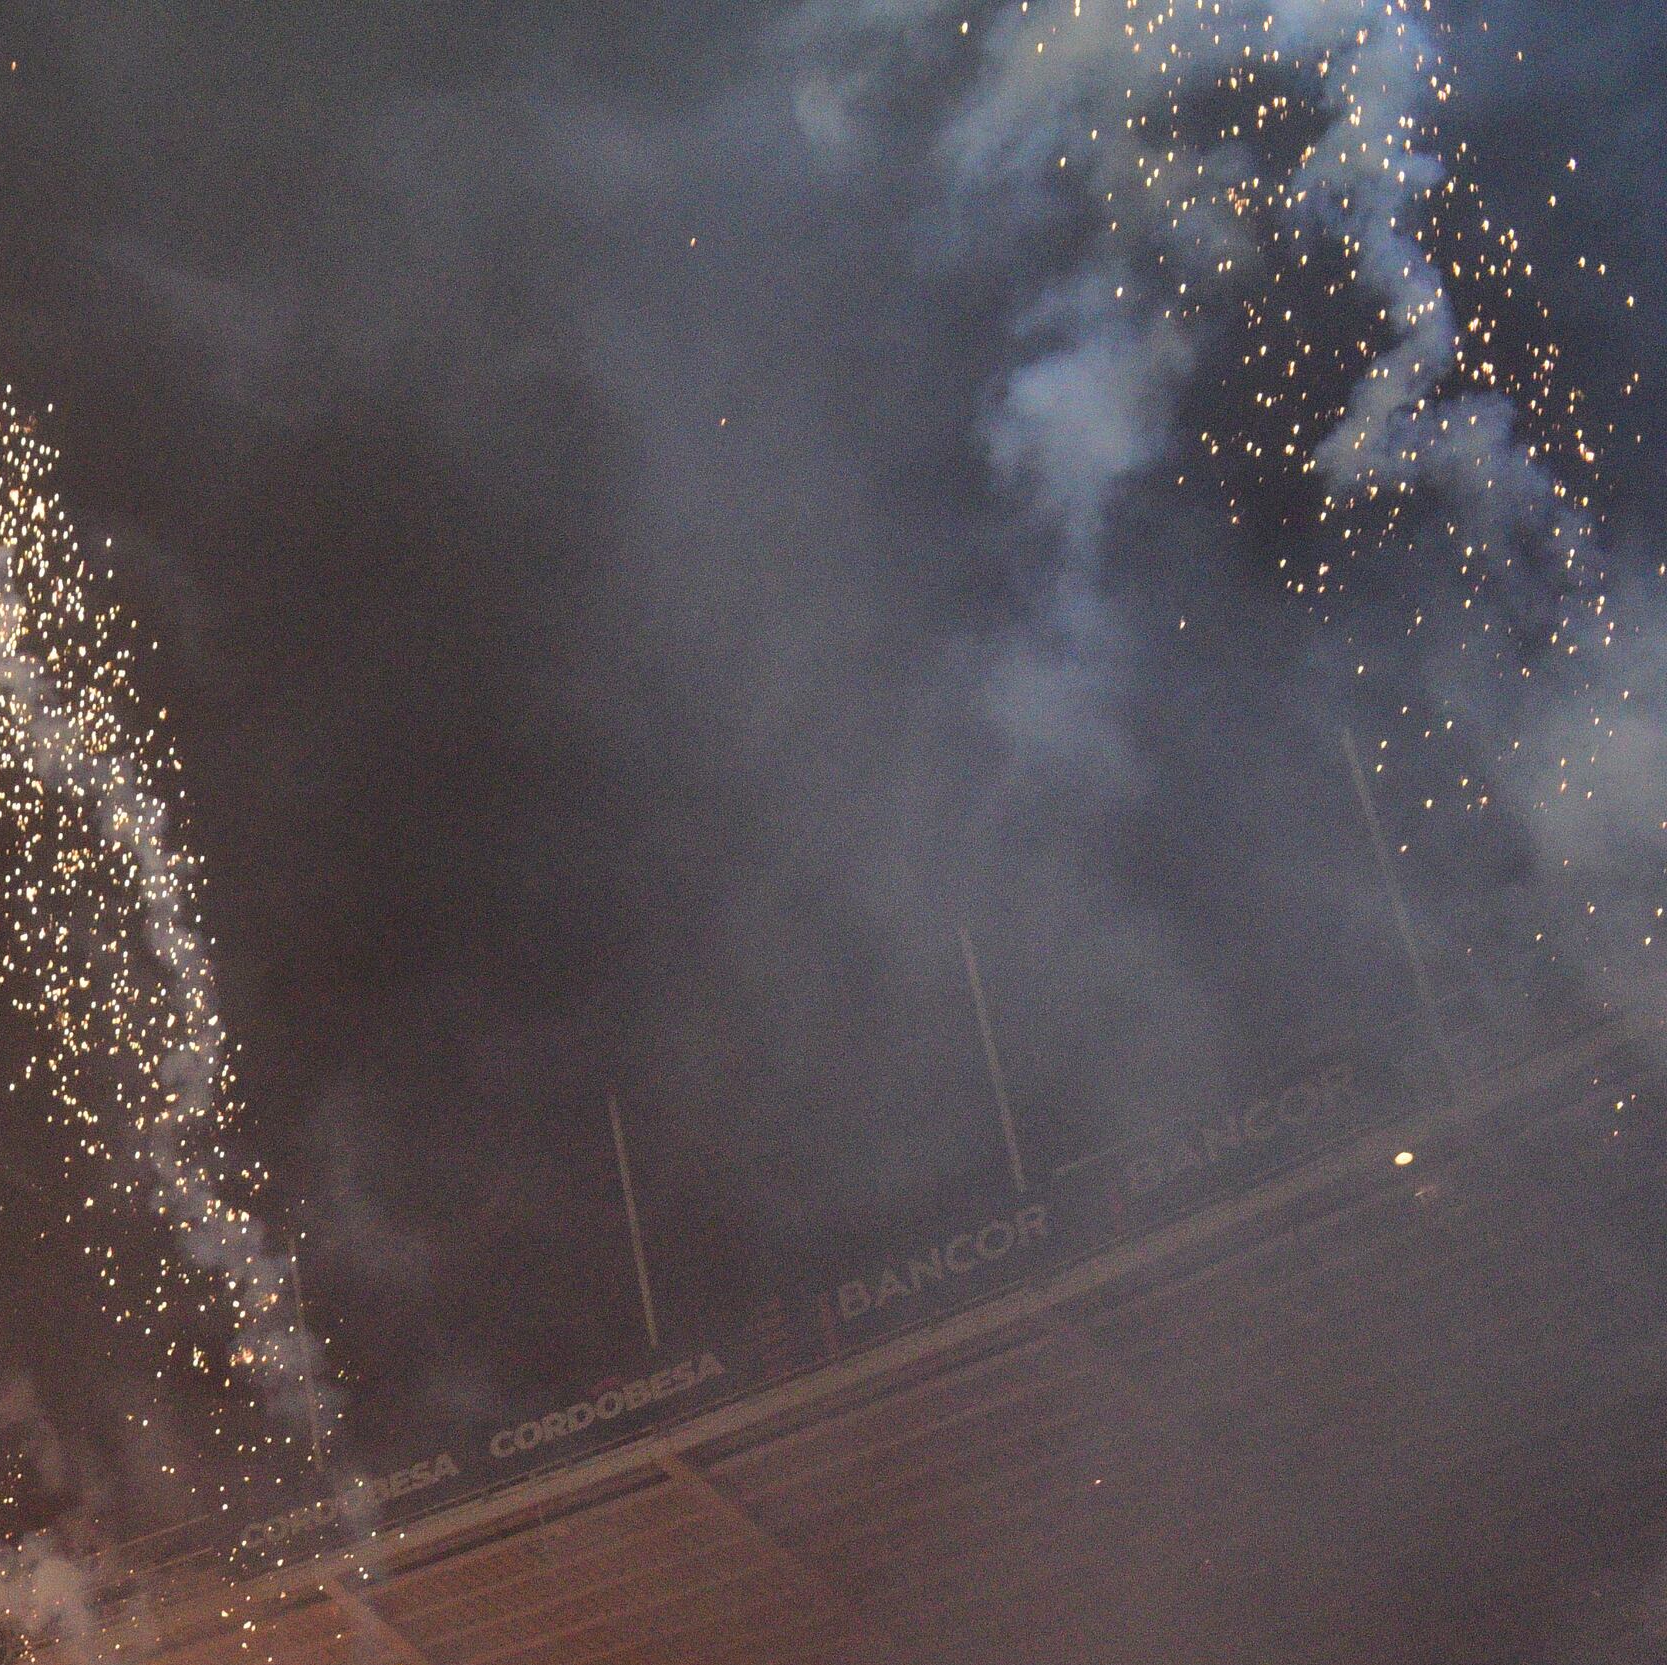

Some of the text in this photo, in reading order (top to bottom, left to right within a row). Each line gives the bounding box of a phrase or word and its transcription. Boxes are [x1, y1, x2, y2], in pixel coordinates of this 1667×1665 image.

[1127, 1063, 1356, 1195] BANCOR
[836, 1202, 1050, 1319] BANCOR
[489, 1351, 725, 1458] CORDOBESA
